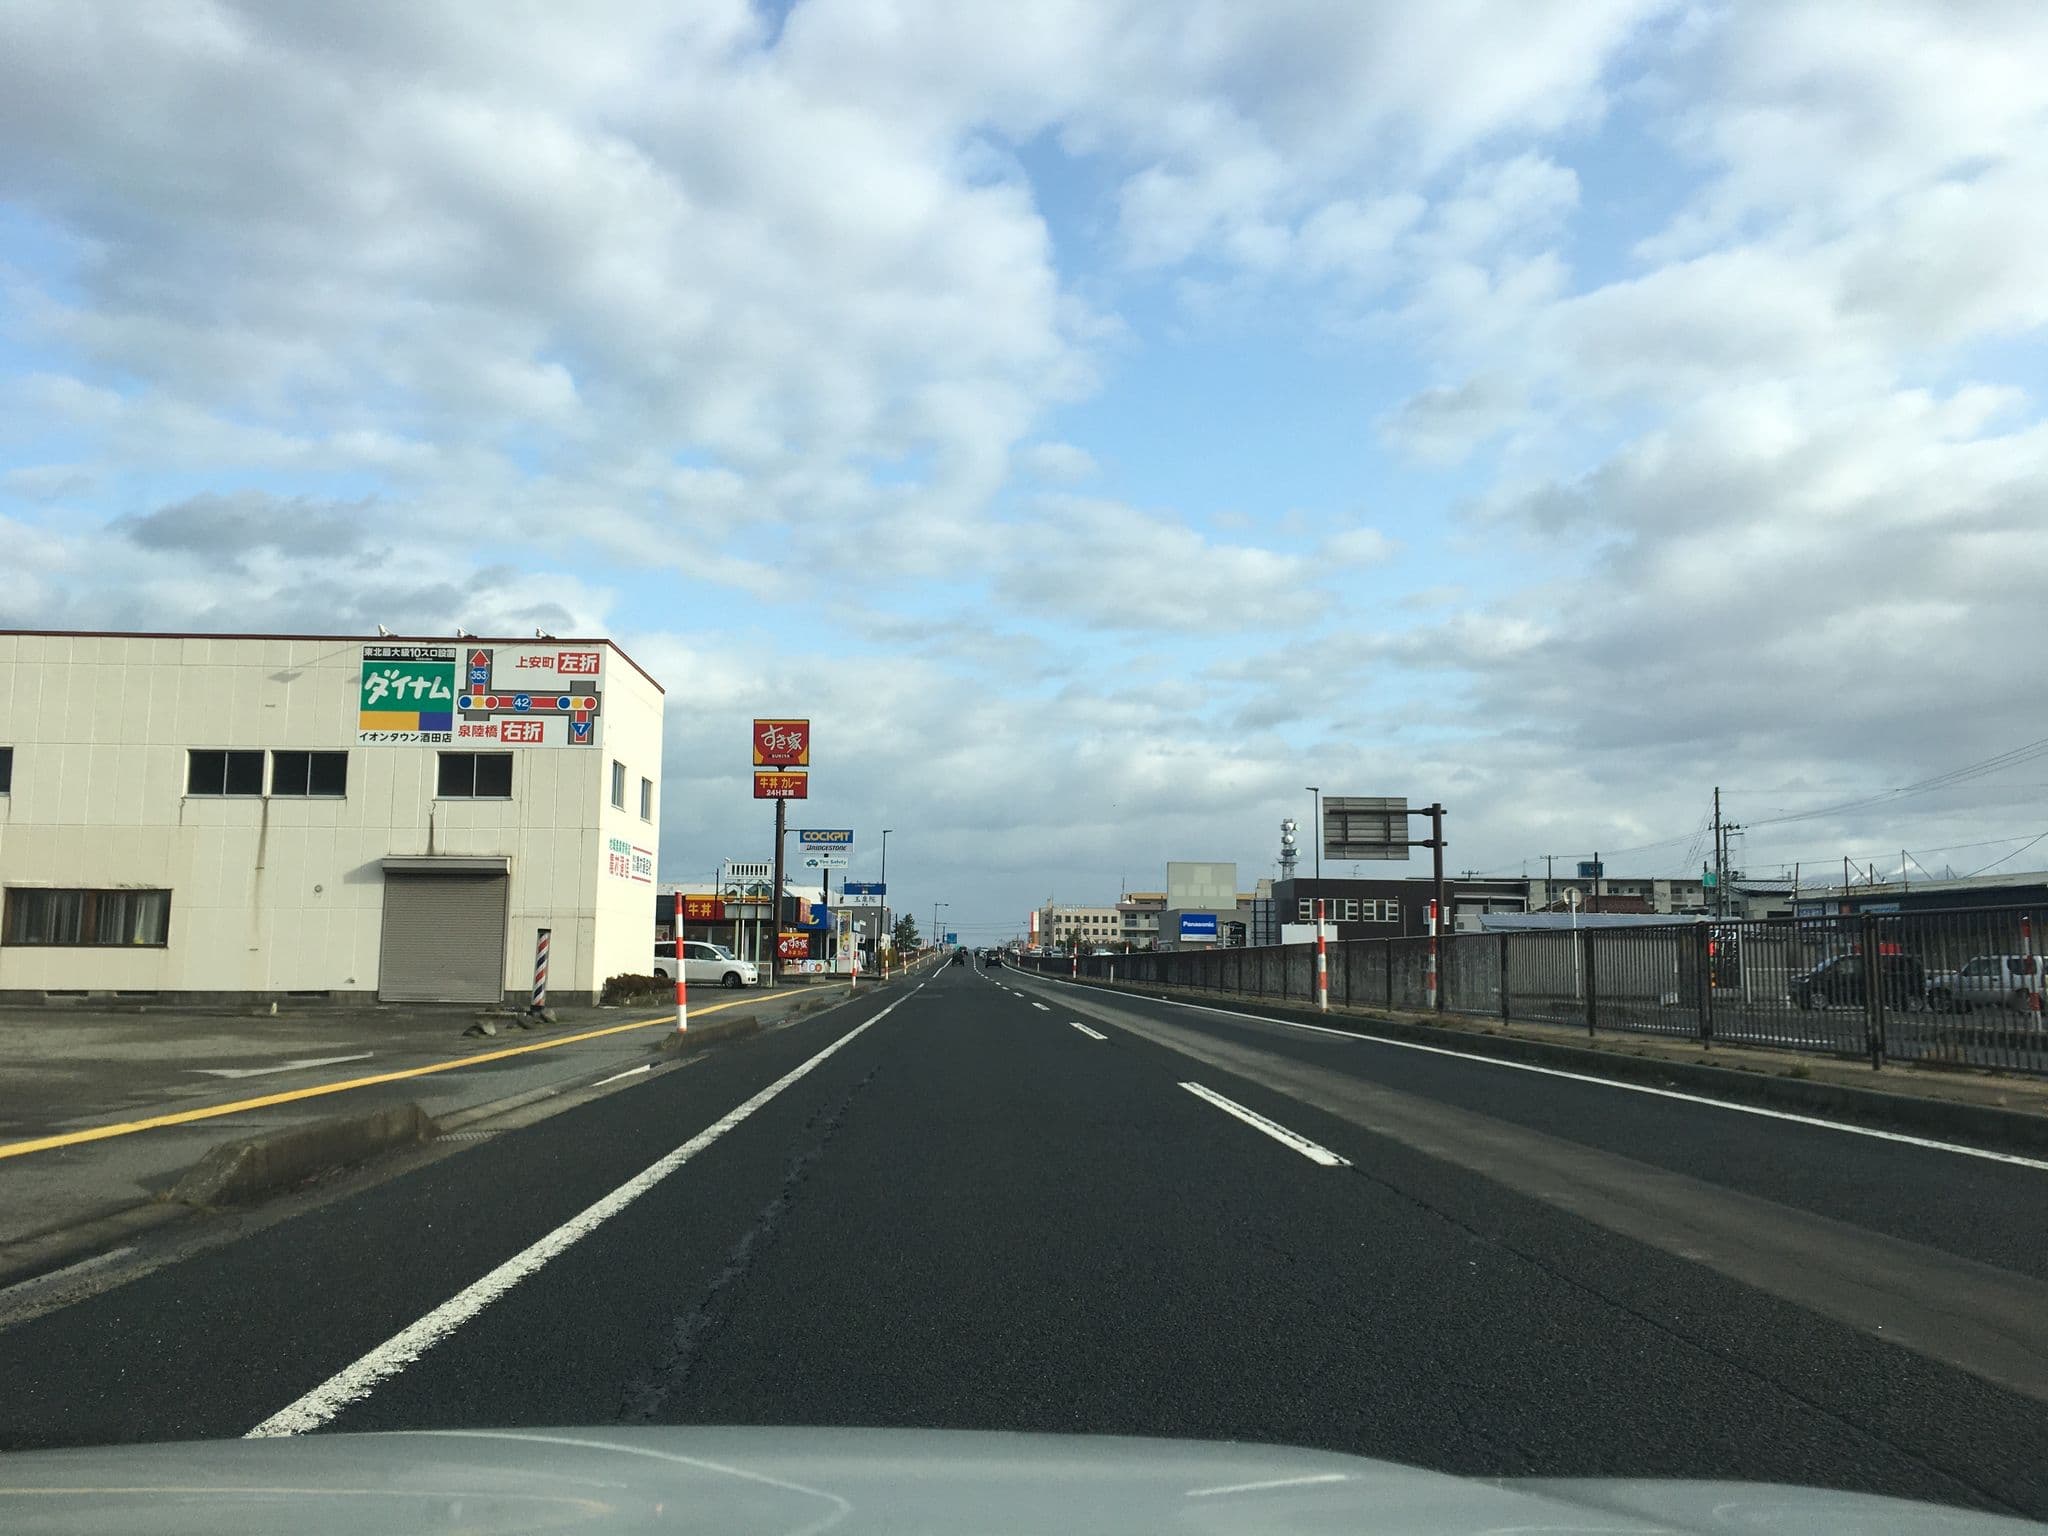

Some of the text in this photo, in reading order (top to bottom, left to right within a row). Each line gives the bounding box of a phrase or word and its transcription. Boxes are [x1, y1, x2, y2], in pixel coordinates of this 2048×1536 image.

[516, 654, 597, 673] 上安町 左折
[471, 670, 487, 681] 353
[364, 668, 452, 705] ダイナム
[514, 697, 529, 707] 42
[458, 722, 542, 742] 泉陸橋 右折
[577, 724, 585, 733] 7
[359, 732, 452, 743] イオンタウン酒田店
[760, 724, 802, 753] すき家
[760, 777, 802, 789] 牛丼 カレー
[803, 831, 850, 842] COCKPIT
[688, 902, 712, 917] 牛丼
[1182, 920, 1215, 928] Panasonic
